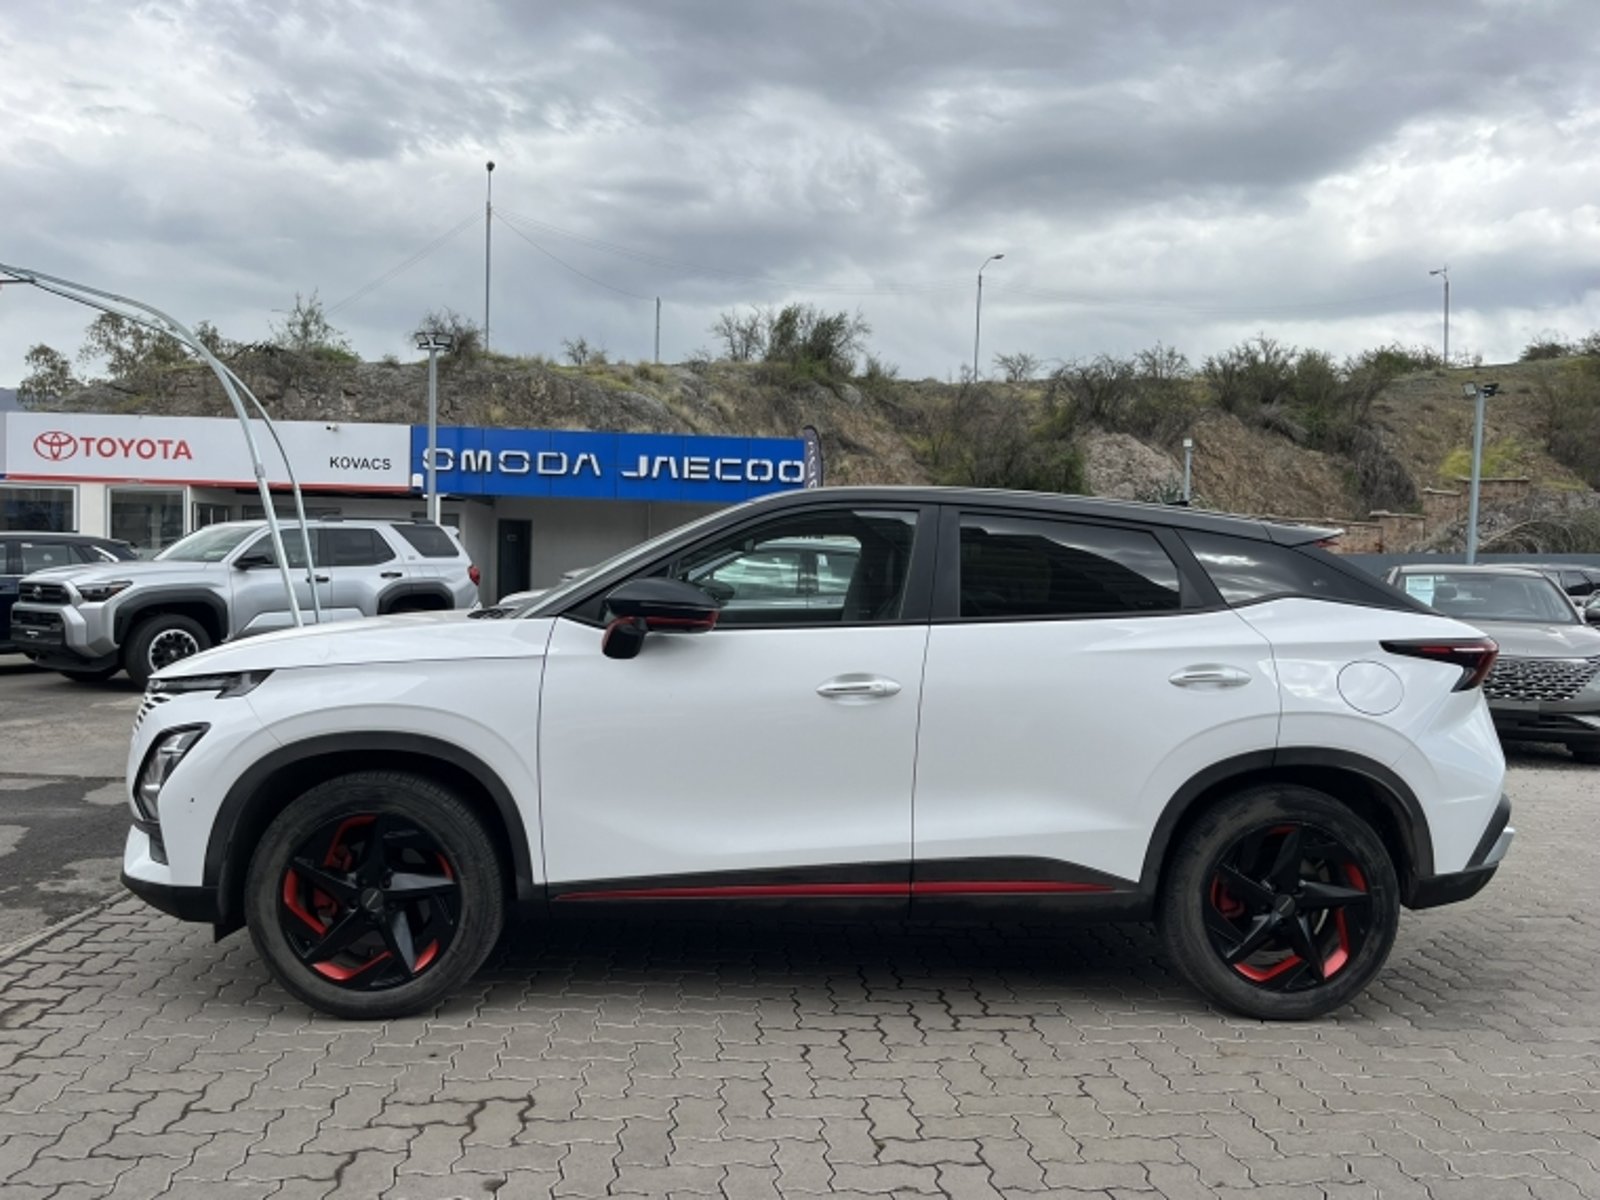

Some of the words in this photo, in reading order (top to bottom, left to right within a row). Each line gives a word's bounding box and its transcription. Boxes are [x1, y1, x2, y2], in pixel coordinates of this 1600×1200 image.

[80, 437, 193, 460] TOYOTA
[329, 455, 392, 471] KOVACS
[422, 447, 602, 477] OMODA
[620, 454, 805, 483] JAECOO
